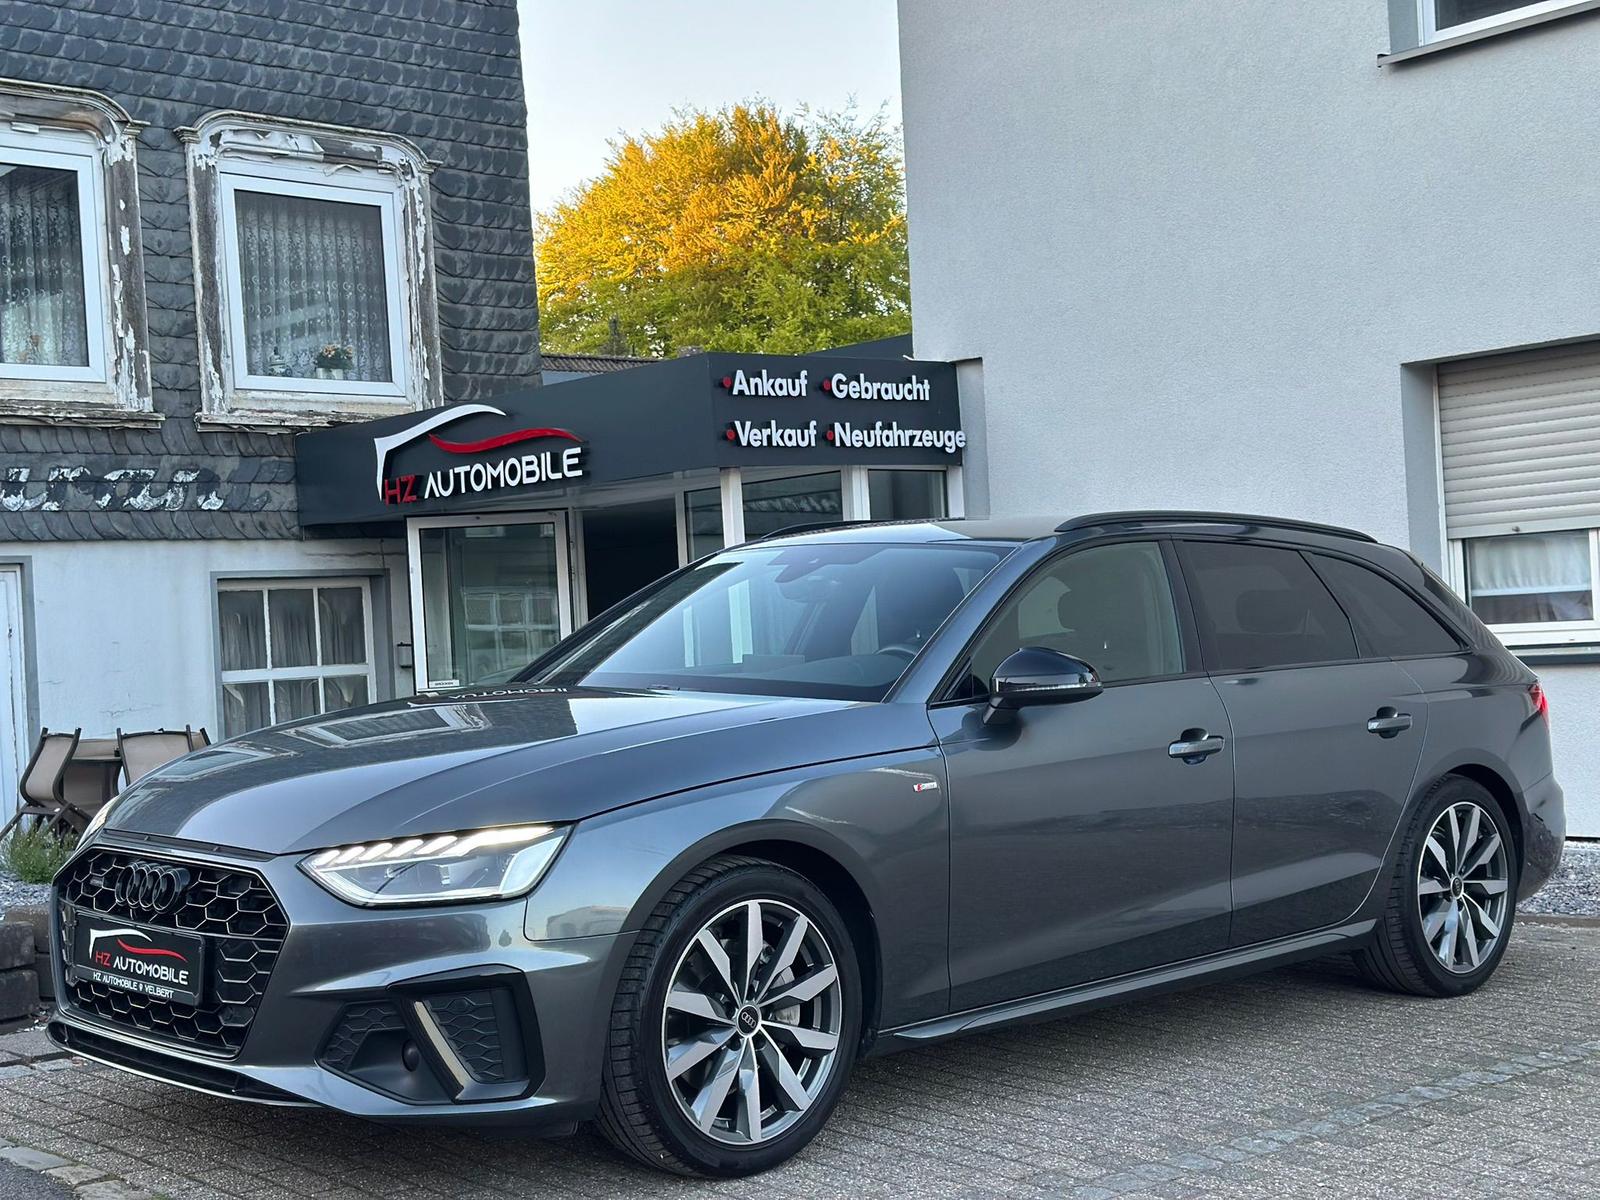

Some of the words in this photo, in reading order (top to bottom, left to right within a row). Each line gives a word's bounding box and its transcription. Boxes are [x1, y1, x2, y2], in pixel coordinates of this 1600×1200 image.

[732, 369, 808, 397] Ankauf
[831, 373, 930, 401] Gebraucht
[734, 420, 817, 448] Verkauf
[834, 421, 966, 453] Neufahrzeuge
[384, 474, 417, 505] HZ
[424, 447, 583, 499] AUTOMOBILE
[95, 951, 111, 967] HZ
[113, 956, 190, 985] AUTOMOBILE
[93, 972, 102, 980] HZ
[102, 975, 138, 991] AUTOMOBILE
[145, 985, 175, 999] VELBERT
